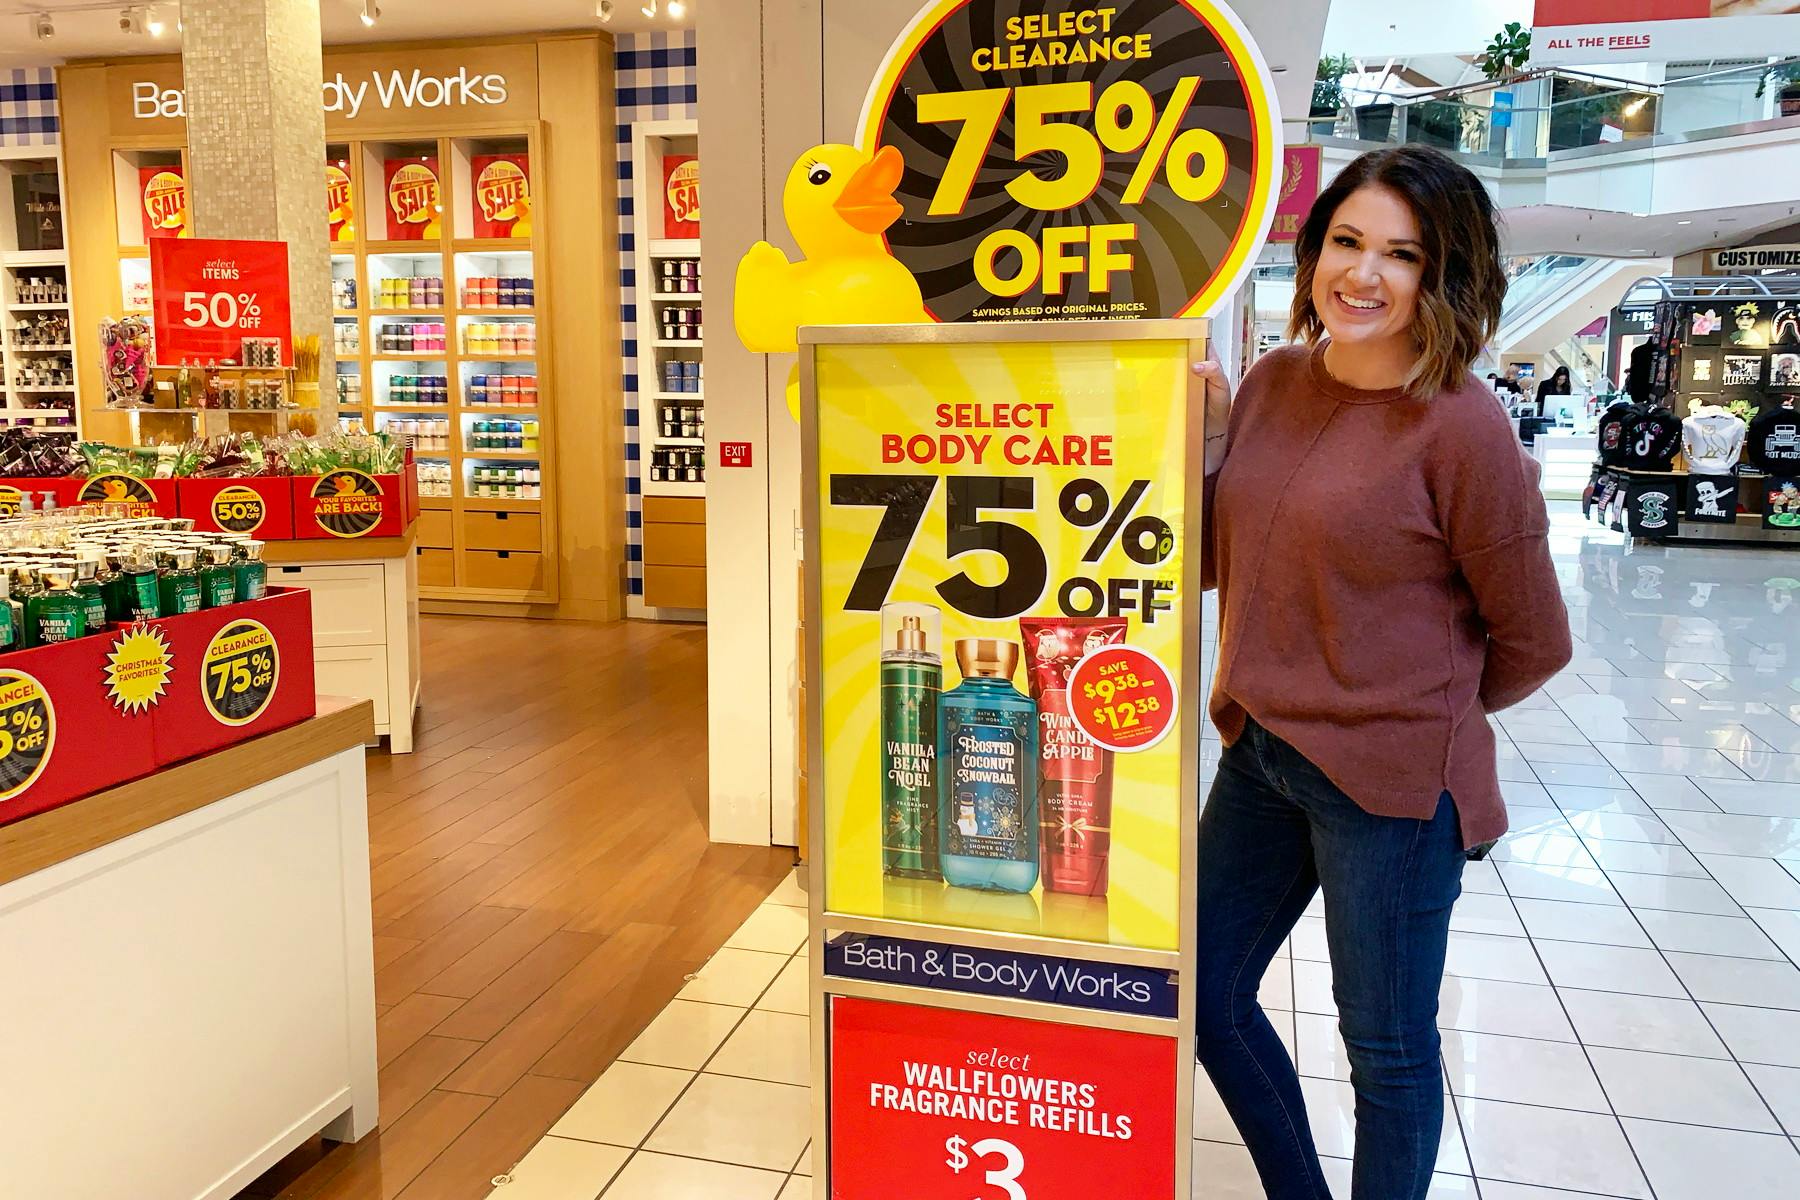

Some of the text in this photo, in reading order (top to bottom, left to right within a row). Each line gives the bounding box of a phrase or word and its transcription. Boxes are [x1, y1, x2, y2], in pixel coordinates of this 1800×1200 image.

[1005, 8, 1117, 41] SELECT
[1547, 34, 1651, 49] ALL THE FEELS
[971, 34, 1152, 73] CLEARANCE
[372, 66, 508, 108] Works
[916, 75, 1229, 217] 75%
[396, 183, 436, 221] SALE
[484, 180, 525, 219] SALE
[205, 258, 236, 269] select
[972, 223, 1137, 298] OFF
[202, 268, 240, 280] ITEMS
[183, 291, 261, 329] 50%
[972, 302, 1148, 317] SAVINGS BASED ON ORIGINAL PRICES.
[239, 316, 262, 329] OFF
[935, 403, 1054, 428] SELECT
[725, 445, 747, 457] EXIT
[881, 434, 1113, 466] BODY CARE
[314, 501, 383, 514] ARE BACK!
[340, 495, 377, 503] FAVORITES
[218, 502, 260, 521] 50%
[246, 511, 261, 519] OFF
[829, 474, 1174, 619] 75%
[1057, 576, 1174, 624] OFF
[39, 619, 71, 627] VANILLA
[44, 625, 68, 634] BEAN
[40, 633, 68, 643] NOEL
[211, 632, 267, 656] CLEARANCE!
[115, 656, 163, 673] CHRISTMAS
[1098, 661, 1129, 677] SAVE
[119, 668, 160, 682] FAVORITES!
[210, 651, 271, 701] 75%
[252, 671, 272, 688] OFF
[16, 730, 45, 752] OFF
[886, 741, 936, 760] VANILLA
[958, 735, 1016, 757] FROSTED
[1043, 743, 1095, 761] APPLE
[893, 756, 930, 773] BEAN
[961, 754, 1016, 772] COCONUT
[888, 769, 931, 792] NOEL
[957, 768, 1016, 785] SNOWBALL
[896, 800, 929, 809] FRAGRANCE
[1069, 799, 1093, 807] CREAM
[844, 942, 1152, 1003] Bath & Body Works
[965, 1047, 1031, 1072] select
[903, 1060, 1098, 1108] WALLFLOWERS
[870, 1082, 1132, 1140] FRAGRANCE REFILLS
